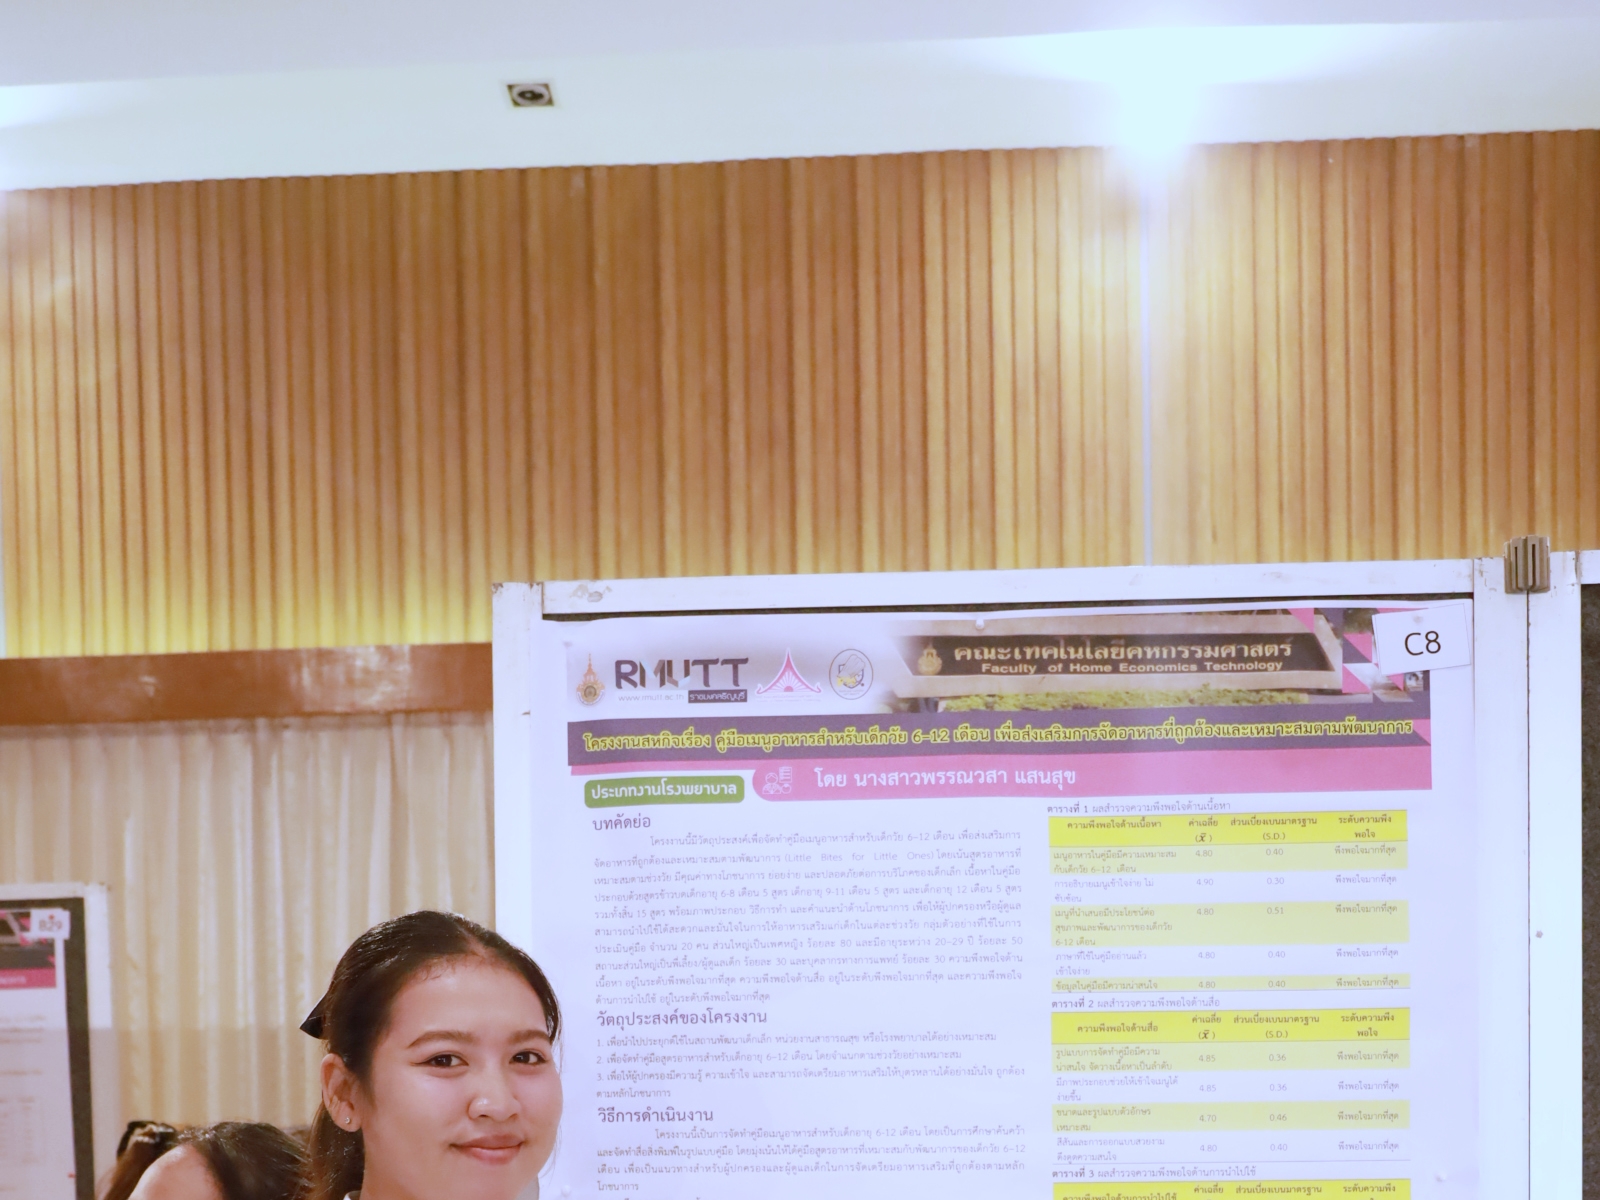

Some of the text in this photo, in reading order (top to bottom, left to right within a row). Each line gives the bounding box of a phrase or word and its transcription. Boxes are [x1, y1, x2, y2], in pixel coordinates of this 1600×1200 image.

[1404, 631, 1442, 656] C8
[615, 658, 748, 689] RMUTT
[980, 661, 1285, 674] Faculty of Home Economics Technology
[583, 730, 710, 753] โครงงานสหกิจเรื่อง
[714, 726, 909, 755] คู่มือเมนูอาหารสำหรับเด็กวัย
[953, 723, 990, 743] เดือน
[994, 717, 1415, 744] เพื่อส่งเสริมการจัดอาหารที่ถูกต้องและเหมาะสมตามพัฒนาการ
[814, 769, 1075, 790] โดย นางสาวพรรณวสา แสนสุข
[589, 779, 739, 799] ประเภทงานโรงพยาบาล
[1047, 801, 1082, 813] ตารางที่
[1084, 805, 1087, 813] 1
[592, 814, 650, 830] บทคัดย่อ
[1193, 850, 1212, 858] 4.80
[1264, 848, 1285, 856] 0.40
[1267, 877, 1284, 885] 0.30
[739, 887, 759, 897] เดือน
[763, 889, 768, 897] 5
[772, 890, 787, 899] สูตร
[792, 888, 822, 898] เด็กอายุ
[849, 885, 870, 895] เดือน
[875, 887, 879, 895] 5
[883, 888, 899, 898] สูตร
[903, 884, 952, 896] และเด็กอายุ
[957, 885, 967, 893] 12
[971, 883, 992, 893] เดือน
[997, 885, 1001, 893] 5
[1005, 886, 1021, 896] สูตร
[1052, 996, 1086, 1008] ตารางที่
[1088, 1000, 1093, 1008] 2
[597, 1008, 767, 1030] วัตถุประสงค์ของโครงงาน
[1268, 1053, 1286, 1061] 0.36
[598, 1107, 713, 1122] วิธีการดำเนินงาน
[1052, 1166, 1087, 1178] ตารางที่
[1089, 1170, 1094, 1178] 3
